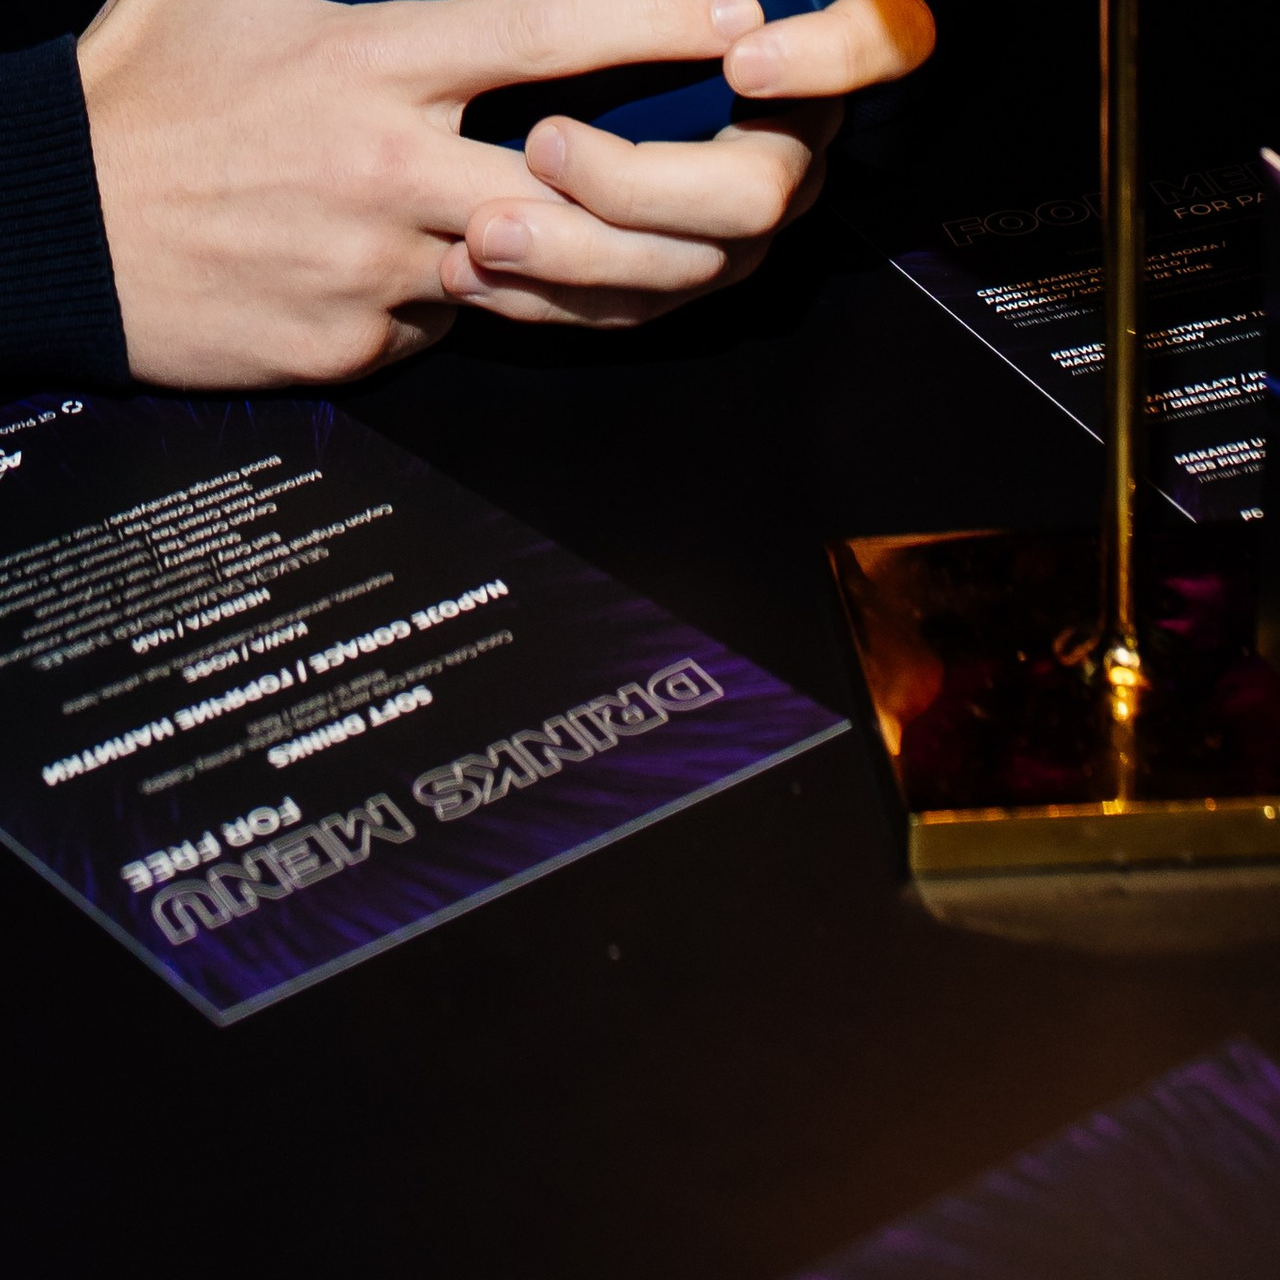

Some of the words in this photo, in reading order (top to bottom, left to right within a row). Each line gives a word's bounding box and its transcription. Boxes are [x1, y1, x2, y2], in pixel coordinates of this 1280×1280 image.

[1149, 160, 1264, 206] ME
[1173, 200, 1232, 220] FOR
[976, 280, 1036, 298] CEVICHE
[984, 287, 1049, 306] PAPRYKA
[1051, 279, 1086, 292] CHILI
[995, 293, 1068, 314] AWOKADO
[1176, 262, 1213, 276] TIGRE
[1170, 386, 1241, 409] DRESSING
[1173, 440, 1251, 466] MAKARON
[1184, 459, 1217, 475] SOS
[186, 586, 271, 632] HERBATA
[410, 578, 507, 631] NAPOJE
[250, 619, 308, 655] KAWA
[305, 615, 410, 675] GORĄCE
[173, 666, 294, 731] ГОРЯЧИЕ
[362, 683, 434, 727] SOFT
[42, 716, 174, 785] НАПИТКИ
[266, 711, 366, 769] DRINKS
[412, 657, 724, 823] DRINKS
[221, 793, 300, 849] FOR
[121, 828, 221, 894] FREE
[151, 791, 416, 945] MENU
